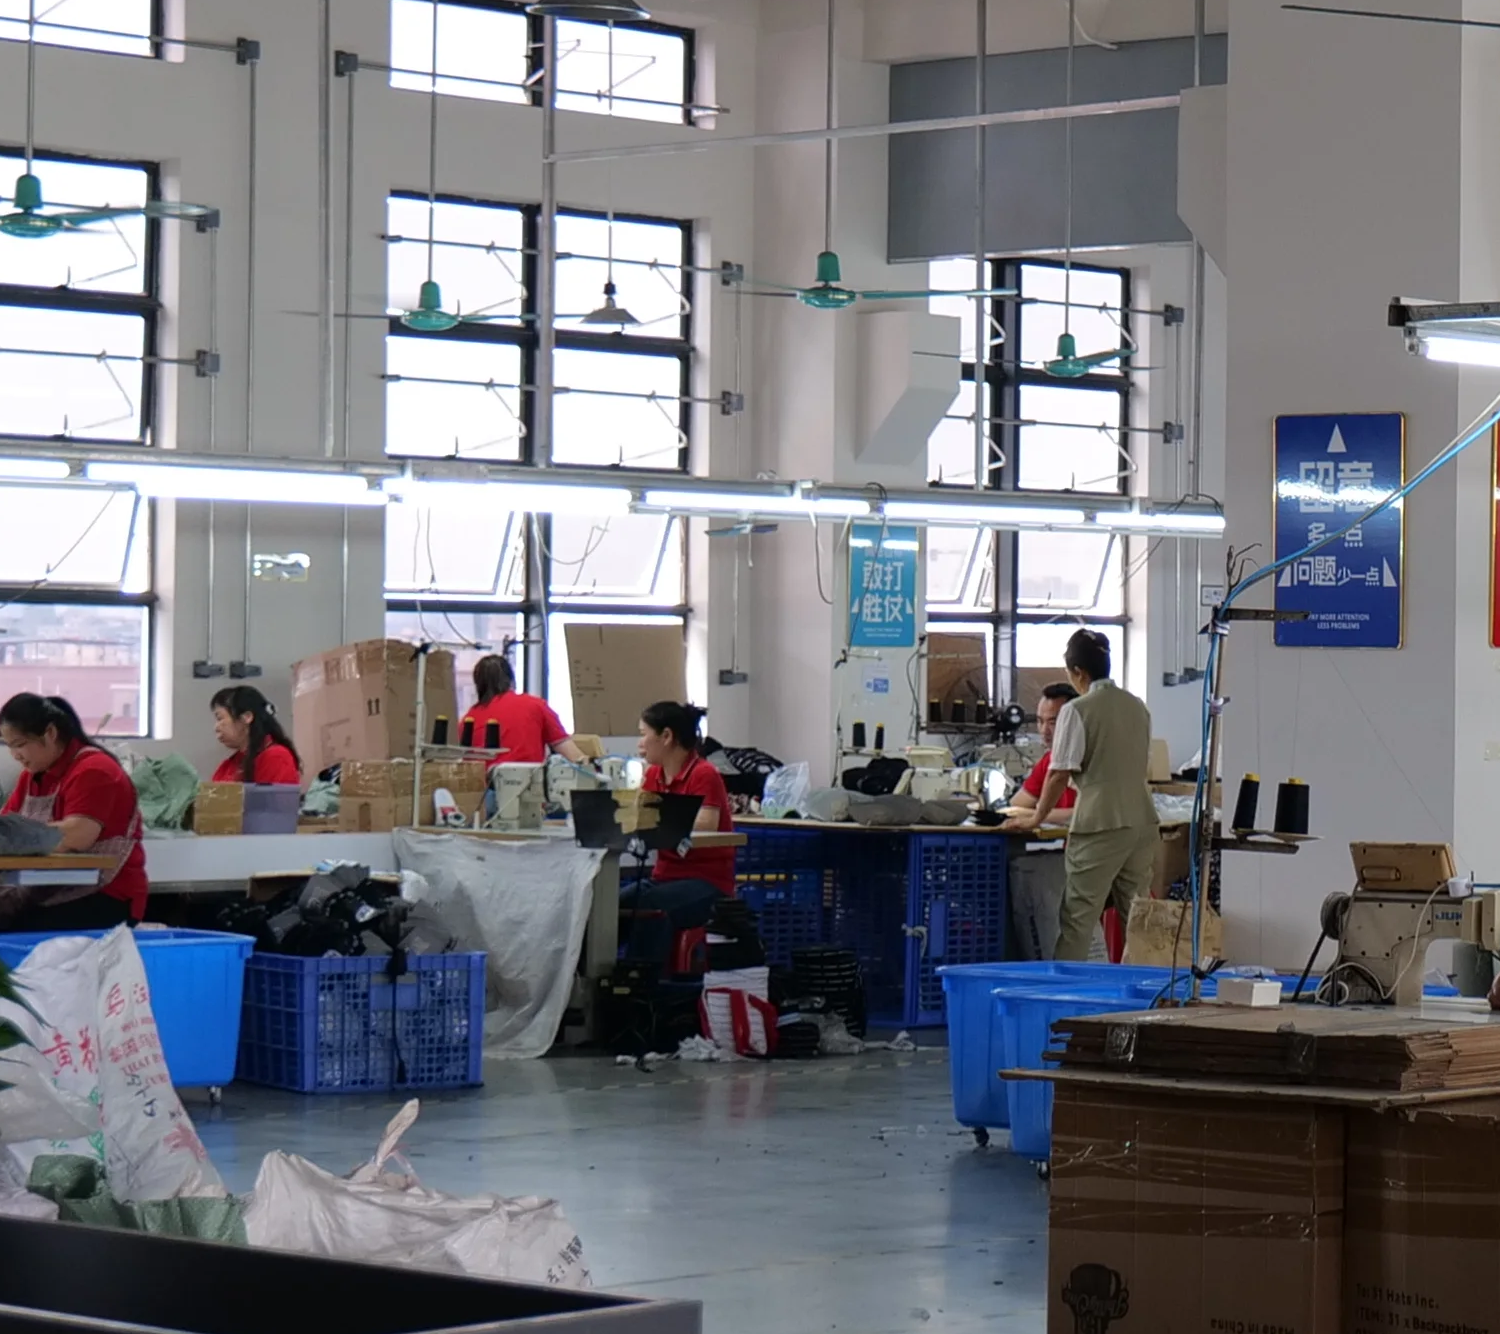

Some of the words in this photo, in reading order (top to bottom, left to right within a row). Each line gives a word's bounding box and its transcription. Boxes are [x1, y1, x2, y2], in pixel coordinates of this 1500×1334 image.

[863, 561, 904, 591] 敢打
[862, 593, 904, 622] 胜仗
[1372, 1285, 1384, 1299] 31
[1386, 1288, 1412, 1307] Hats
[1415, 1293, 1440, 1310] Inc.
[1210, 1318, 1245, 1334] China
[1356, 1307, 1384, 1323] ITEM:
[1388, 1312, 1400, 1326] 31
